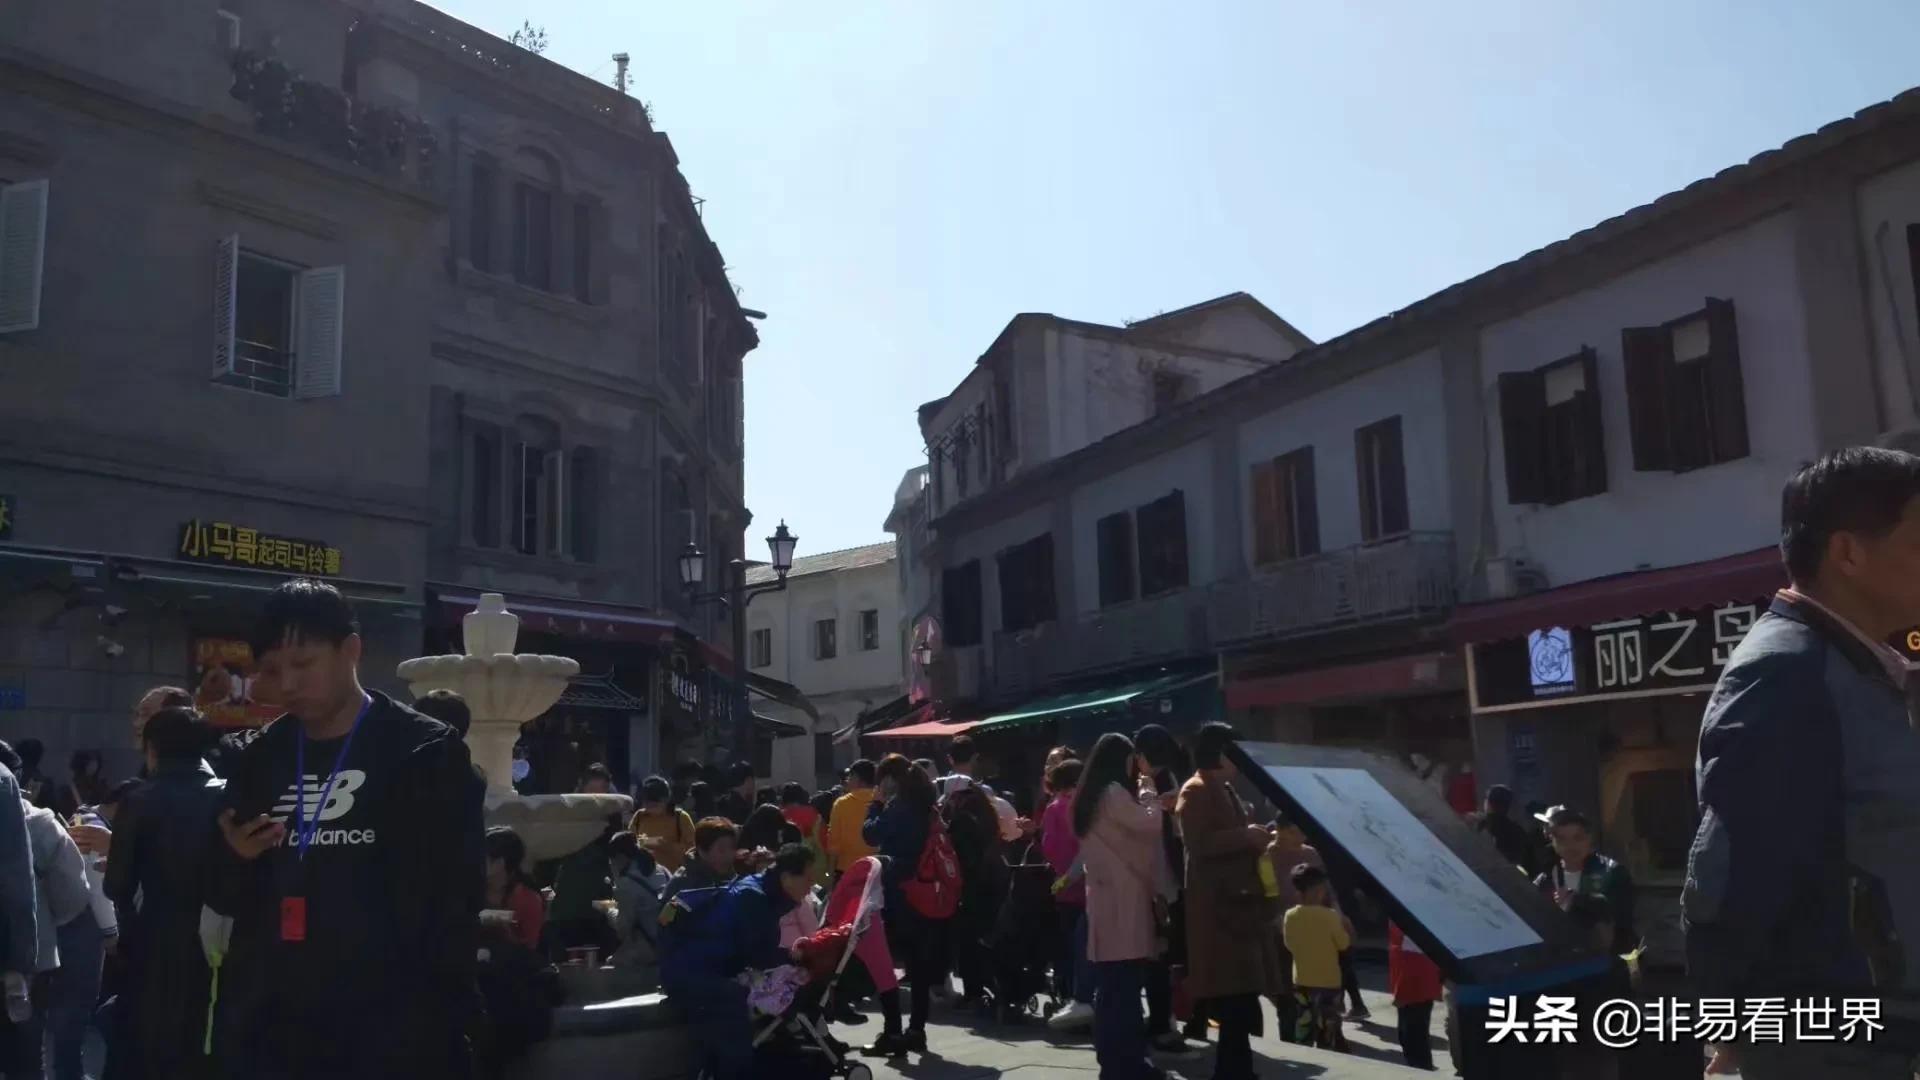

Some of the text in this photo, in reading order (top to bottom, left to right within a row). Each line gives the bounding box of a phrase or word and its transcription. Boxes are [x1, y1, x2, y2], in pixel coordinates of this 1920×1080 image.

[181, 518, 341, 575] 小马哥起司马铃薯
[1591, 602, 1756, 688] 丽之岛
